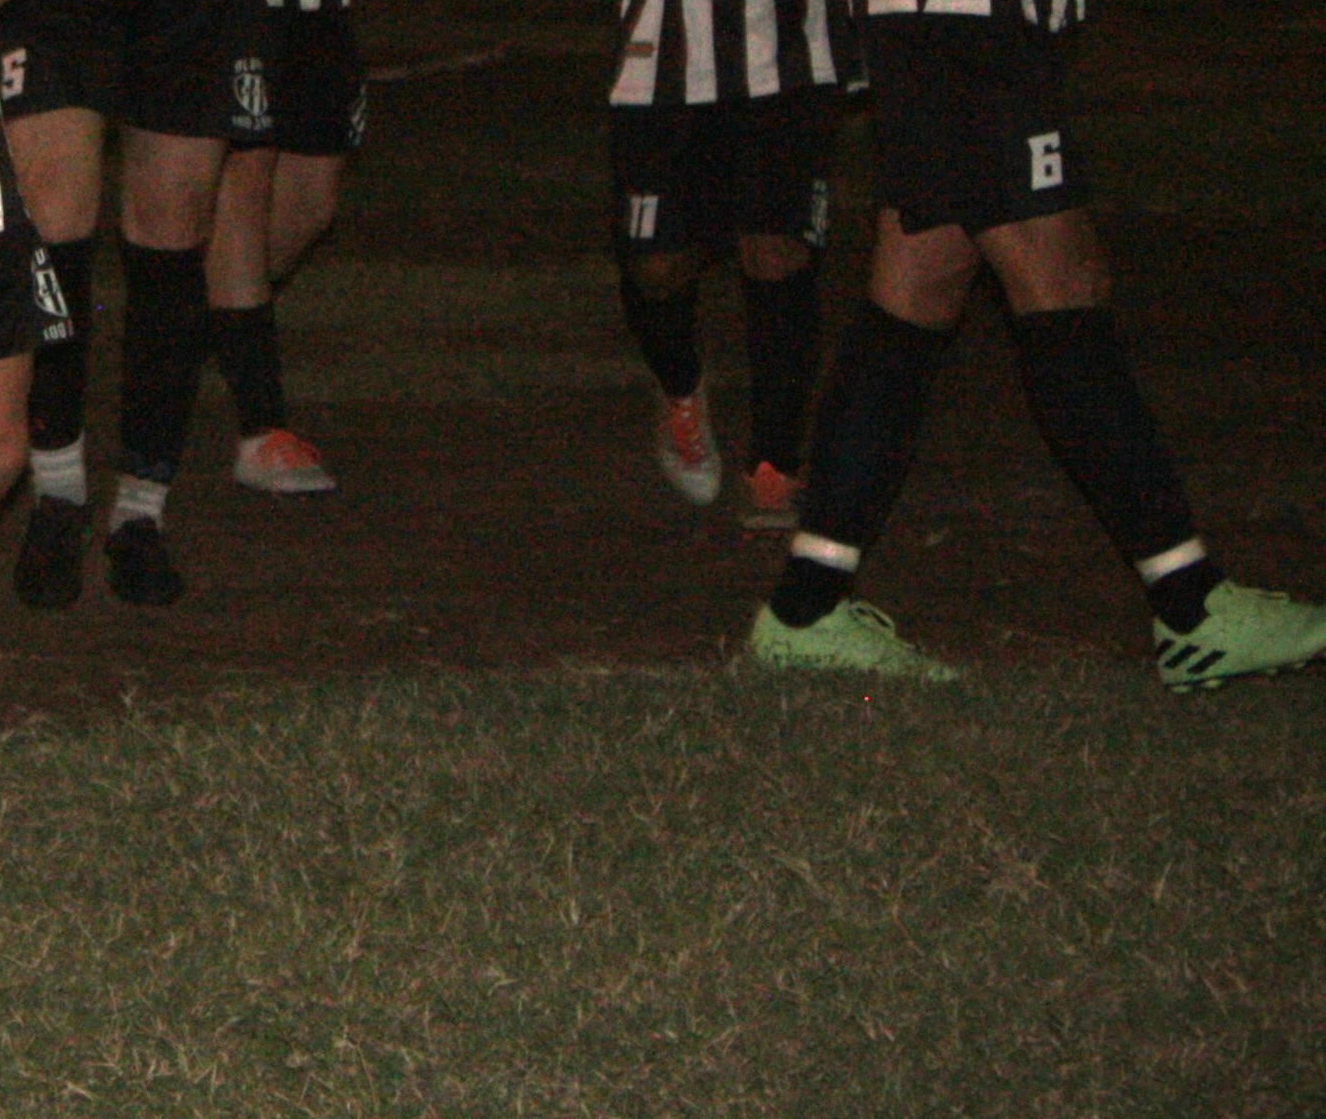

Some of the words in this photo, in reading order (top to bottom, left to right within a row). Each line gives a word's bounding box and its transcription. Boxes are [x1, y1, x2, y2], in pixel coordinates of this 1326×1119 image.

[0, 48, 27, 100] 5
[1027, 131, 1063, 191] 6
[629, 194, 659, 239] 11
